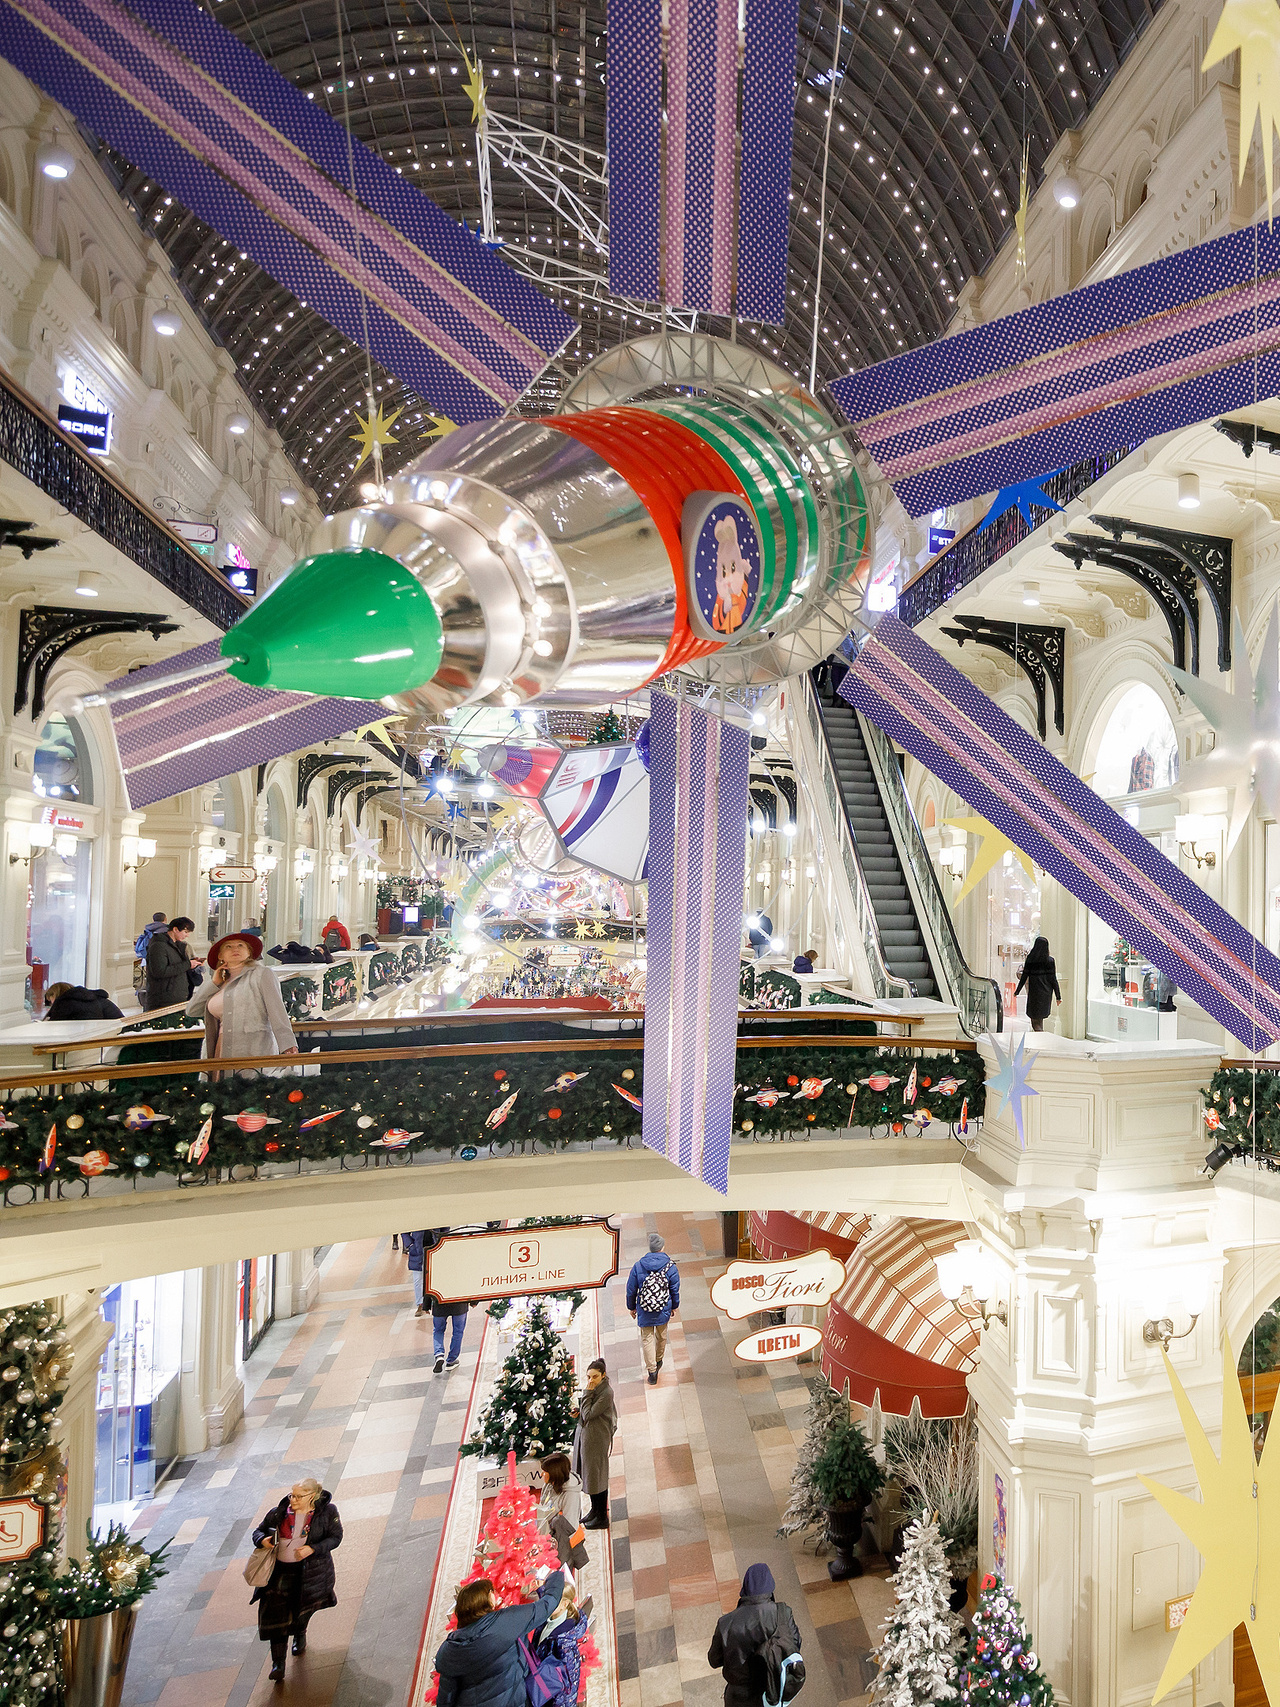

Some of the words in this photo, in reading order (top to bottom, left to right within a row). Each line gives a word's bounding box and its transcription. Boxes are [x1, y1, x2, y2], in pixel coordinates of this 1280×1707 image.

[518, 1246, 531, 1263] 3
[481, 1273, 527, 1287] ЛИНИЯ
[538, 1269, 566, 1280] LINE
[732, 1275, 764, 1291] BOSCO
[752, 1268, 826, 1302] Fiori
[757, 1333, 801, 1355] ЦВЕТЫ
